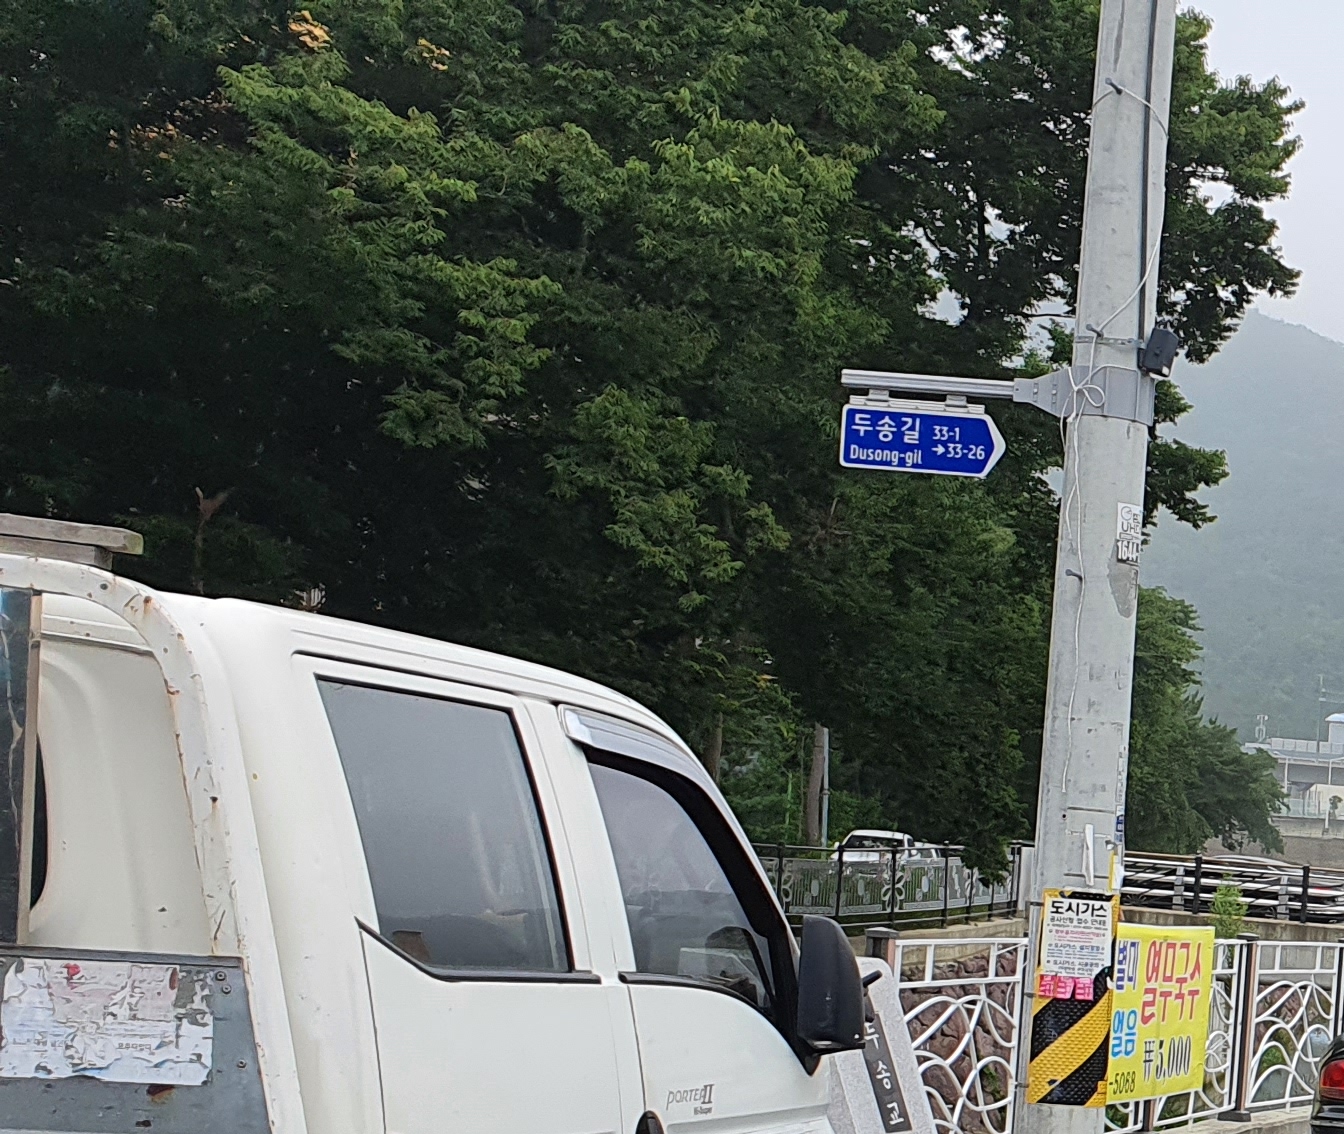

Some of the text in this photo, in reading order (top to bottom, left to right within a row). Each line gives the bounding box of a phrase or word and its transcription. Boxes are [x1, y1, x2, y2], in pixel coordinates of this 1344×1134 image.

[851, 413, 960, 444] 두송길 33-1
[849, 443, 985, 466] Dusong-gil 33-26
[1050, 900, 1107, 918] 도시가스
[1141, 940, 1202, 1025] 열무국수
